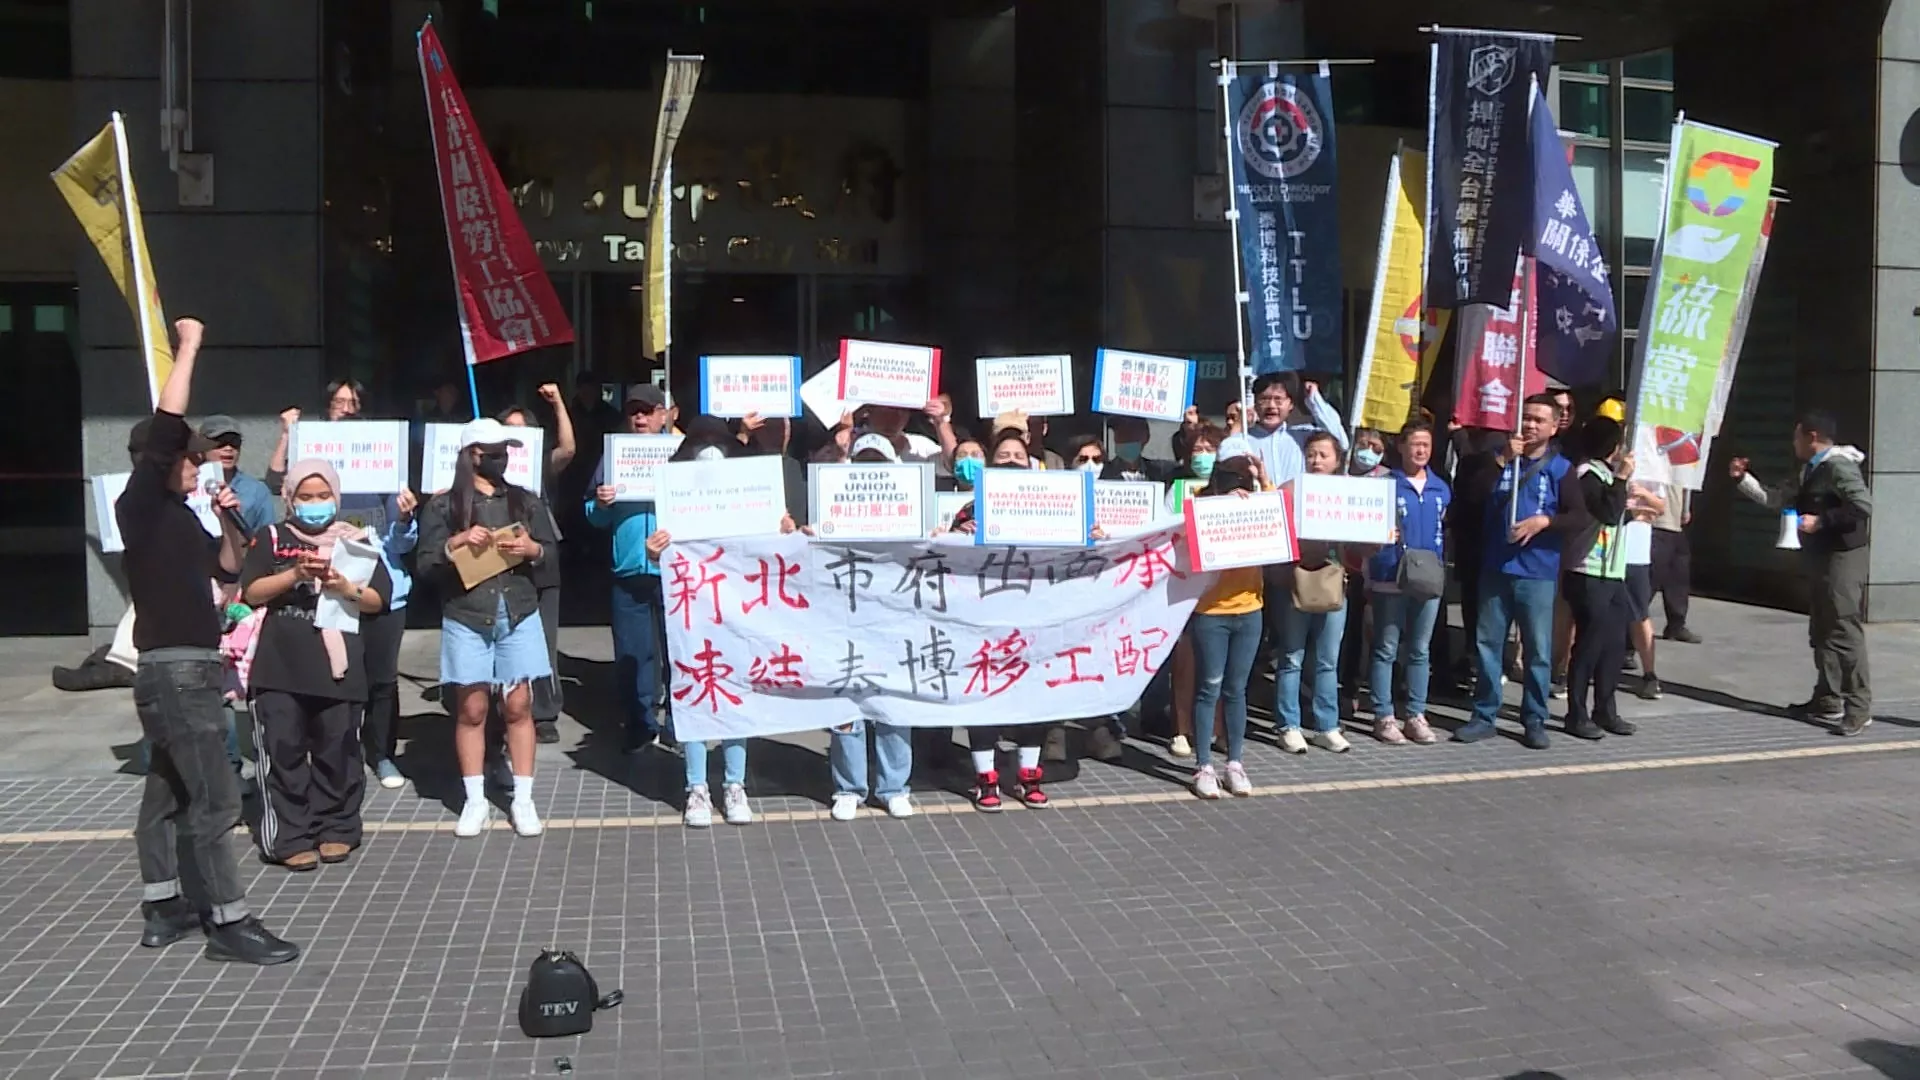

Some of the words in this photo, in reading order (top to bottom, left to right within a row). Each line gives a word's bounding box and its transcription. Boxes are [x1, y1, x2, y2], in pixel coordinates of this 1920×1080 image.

[848, 471, 890, 481] STOP
[844, 482, 897, 492] UNION
[833, 492, 908, 502] BUSTING!
[987, 492, 1078, 501] MANAGEMENT
[1108, 489, 1148, 498] TAIPEI
[992, 501, 1074, 509] INFILTRATION
[991, 508, 1006, 517] OF
[1008, 508, 1034, 517] OUR
[1036, 509, 1076, 517] UNION!
[539, 1000, 579, 1017] TEV
